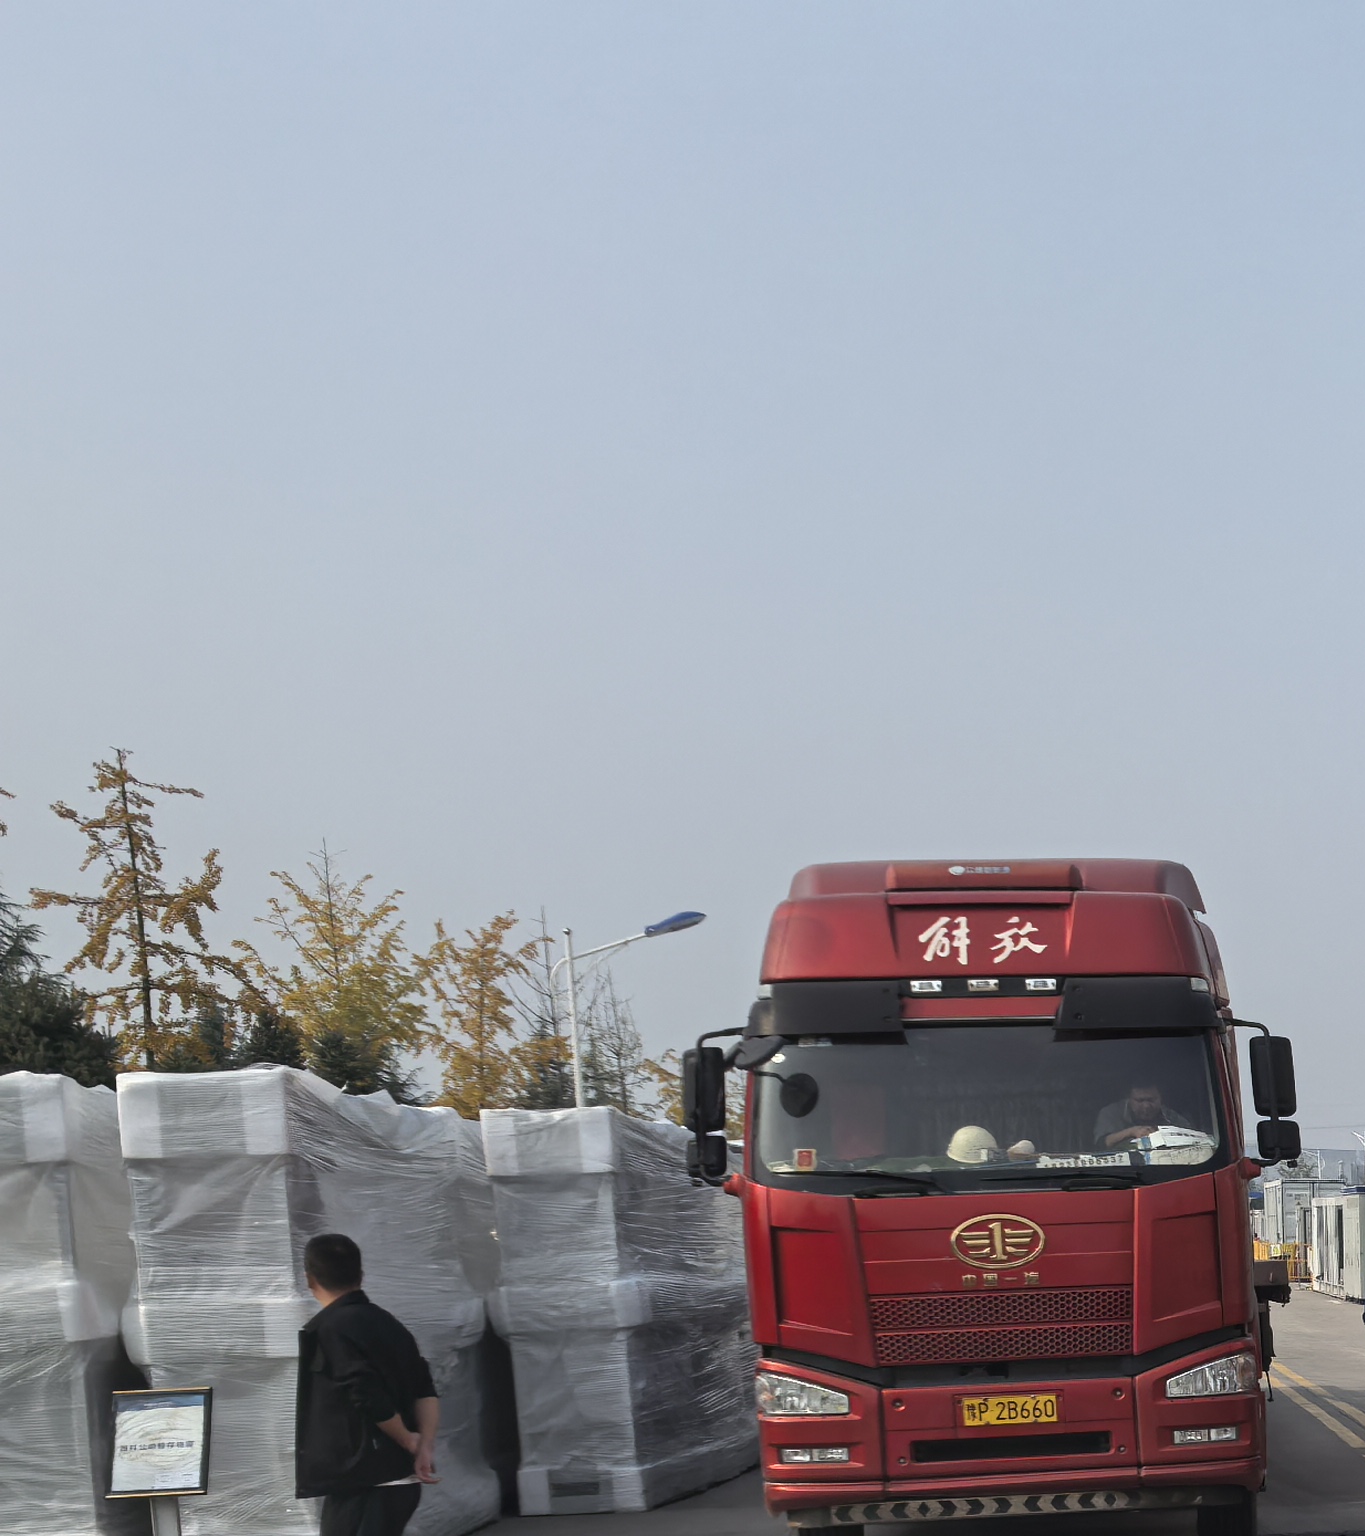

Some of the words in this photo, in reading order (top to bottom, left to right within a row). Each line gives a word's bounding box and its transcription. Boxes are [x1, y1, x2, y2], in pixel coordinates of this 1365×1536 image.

[918, 916, 1048, 965] 解放
[962, 1271, 1039, 1288] 中国一汽
